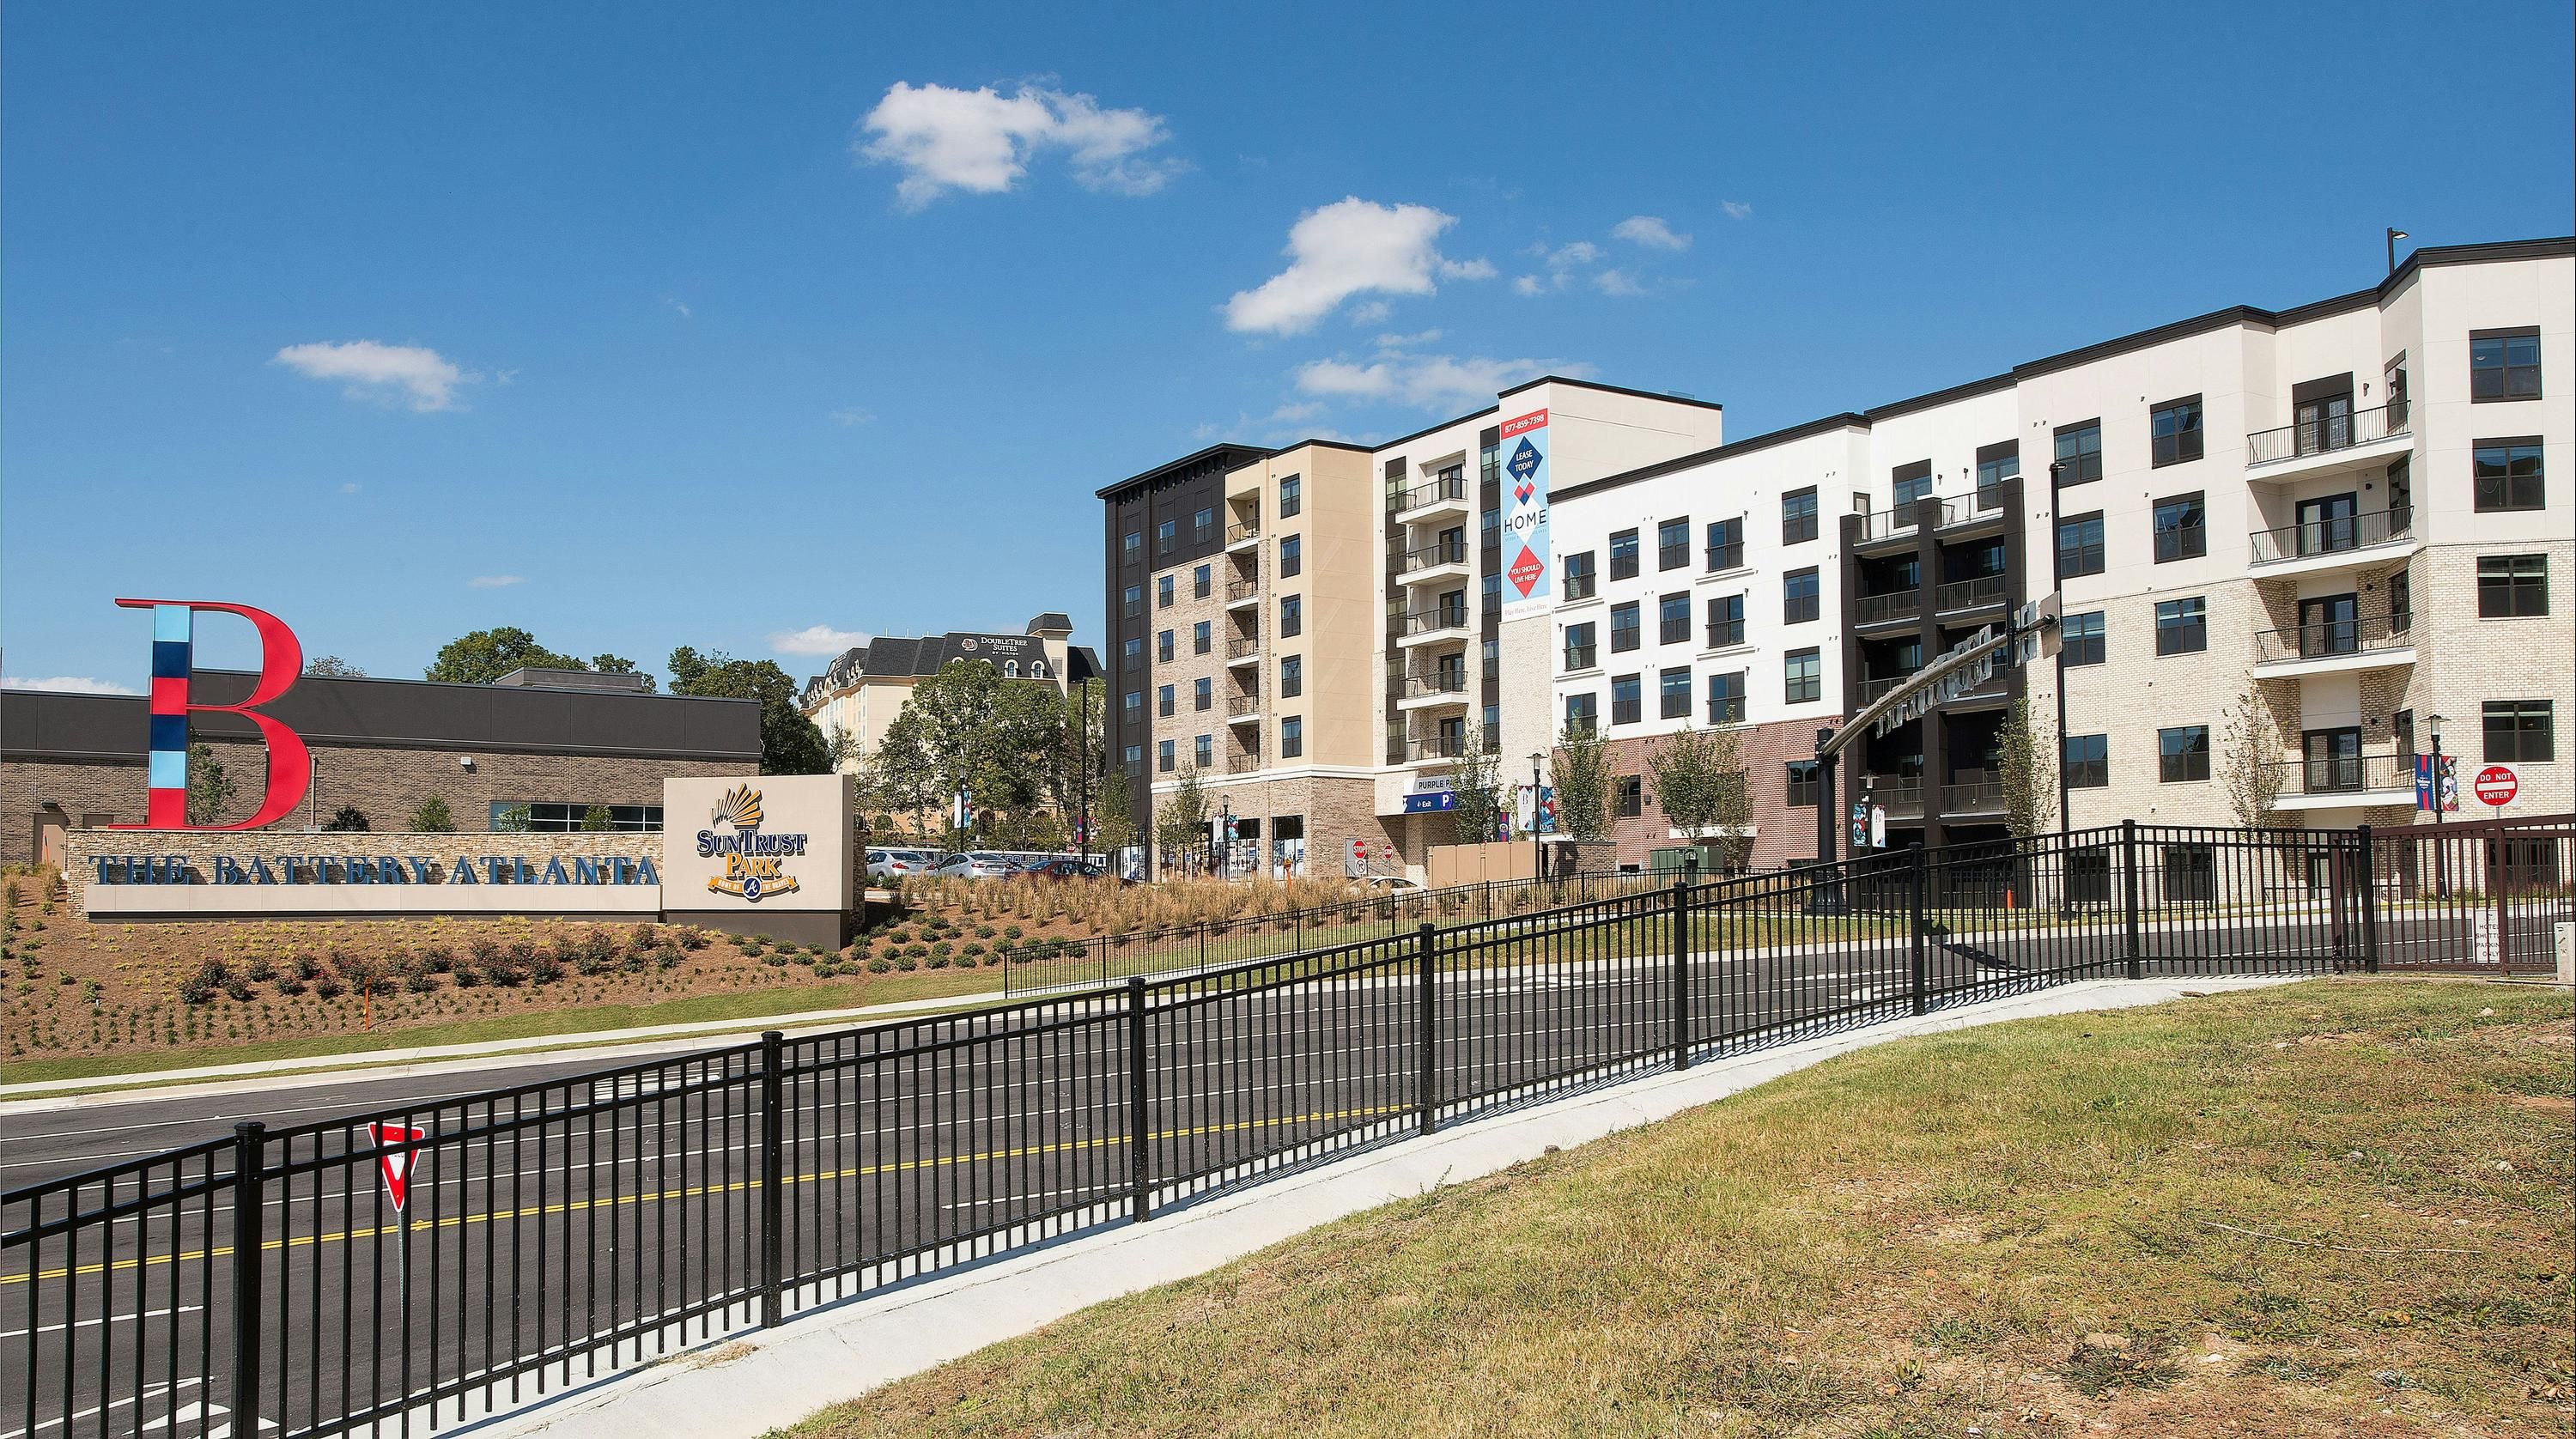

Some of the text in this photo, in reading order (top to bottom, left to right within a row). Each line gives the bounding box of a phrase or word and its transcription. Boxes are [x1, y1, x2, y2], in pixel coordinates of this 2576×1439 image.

[1504, 414, 1544, 433] 877-859-7398
[1516, 449, 1533, 461] LEASE
[1515, 460, 1534, 472] TODAY
[1504, 509, 1546, 532] HOME
[1521, 563, 1540, 574] SHOULD
[1524, 573, 1537, 581] HERE
[108, 598, 311, 832] B
[1419, 780, 1443, 789] PURPLE
[1443, 794, 1449, 807] P
[1522, 794, 1528, 805] B
[2483, 791, 2509, 799] ENTER
[88, 855, 659, 885] THE BATTERY ATLANTA
[718, 879, 732, 888] HOME
[732, 882, 740, 890] OF
[762, 882, 771, 890] THE
